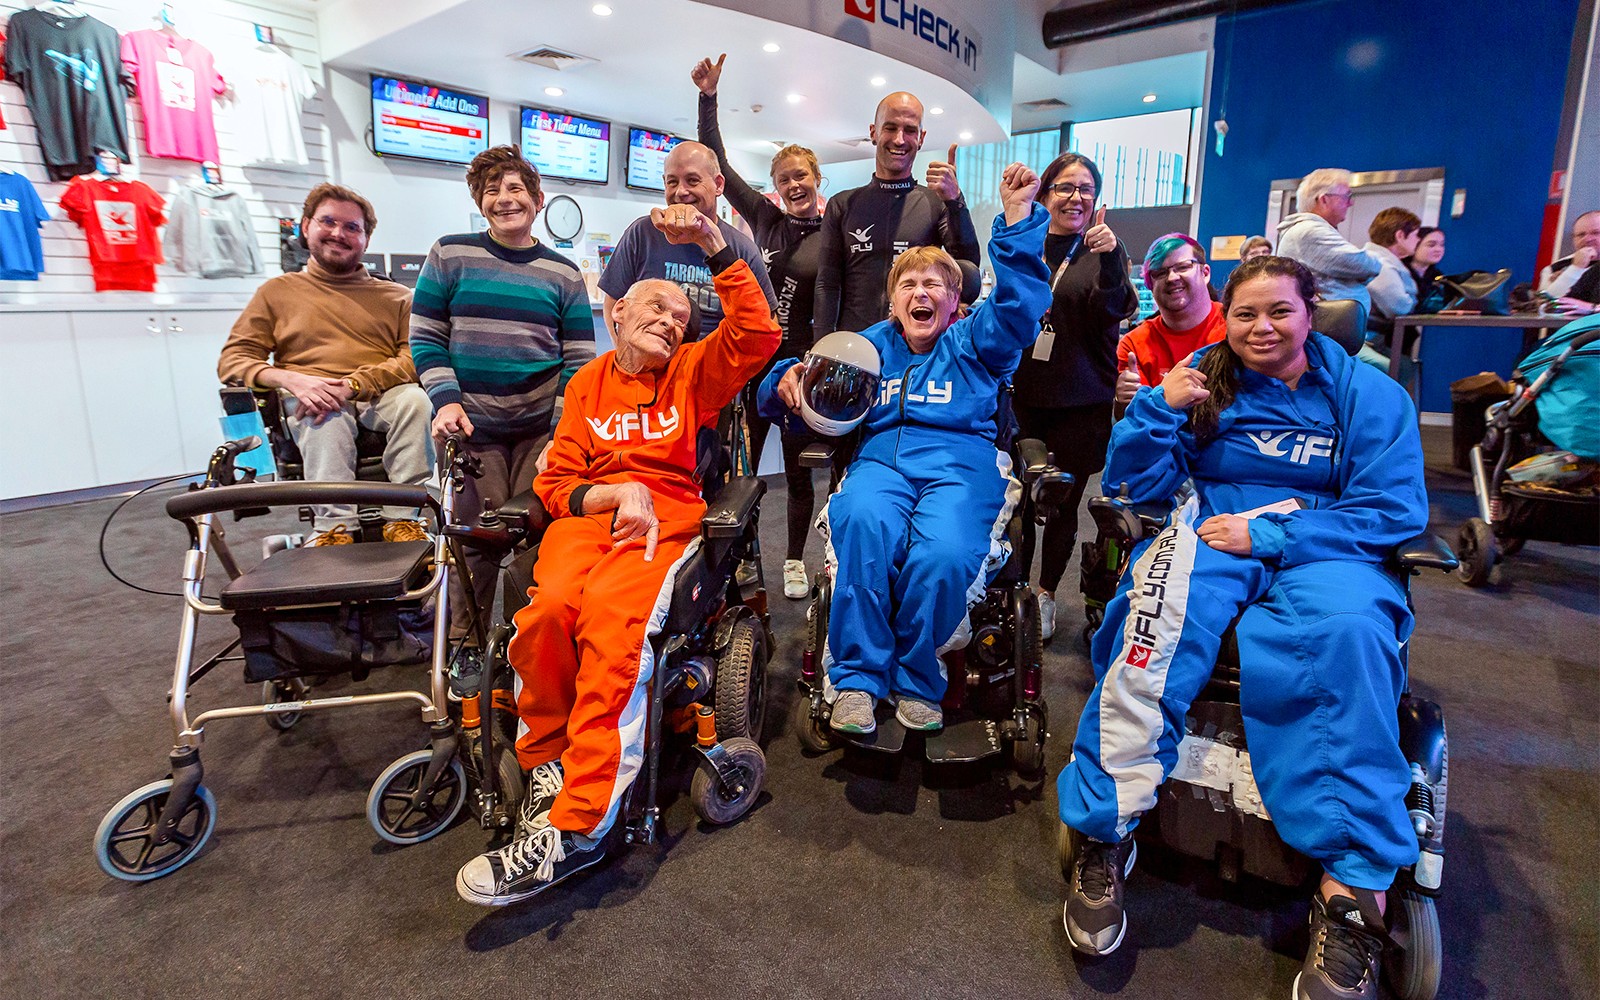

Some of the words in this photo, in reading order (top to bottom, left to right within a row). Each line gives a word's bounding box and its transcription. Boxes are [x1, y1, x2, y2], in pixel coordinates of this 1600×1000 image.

[385, 83, 435, 107] Ultimate
[435, 95, 458, 111] Add
[458, 98, 479, 115] Ons
[531, 115, 553, 130] First
[553, 118, 578, 134] Timer
[578, 123, 602, 138] Menu
[639, 135, 660, 150] Group
[850, 243, 873, 253] iFLY
[665, 262, 713, 284] TARONG
[615, 405, 680, 441] iFLY
